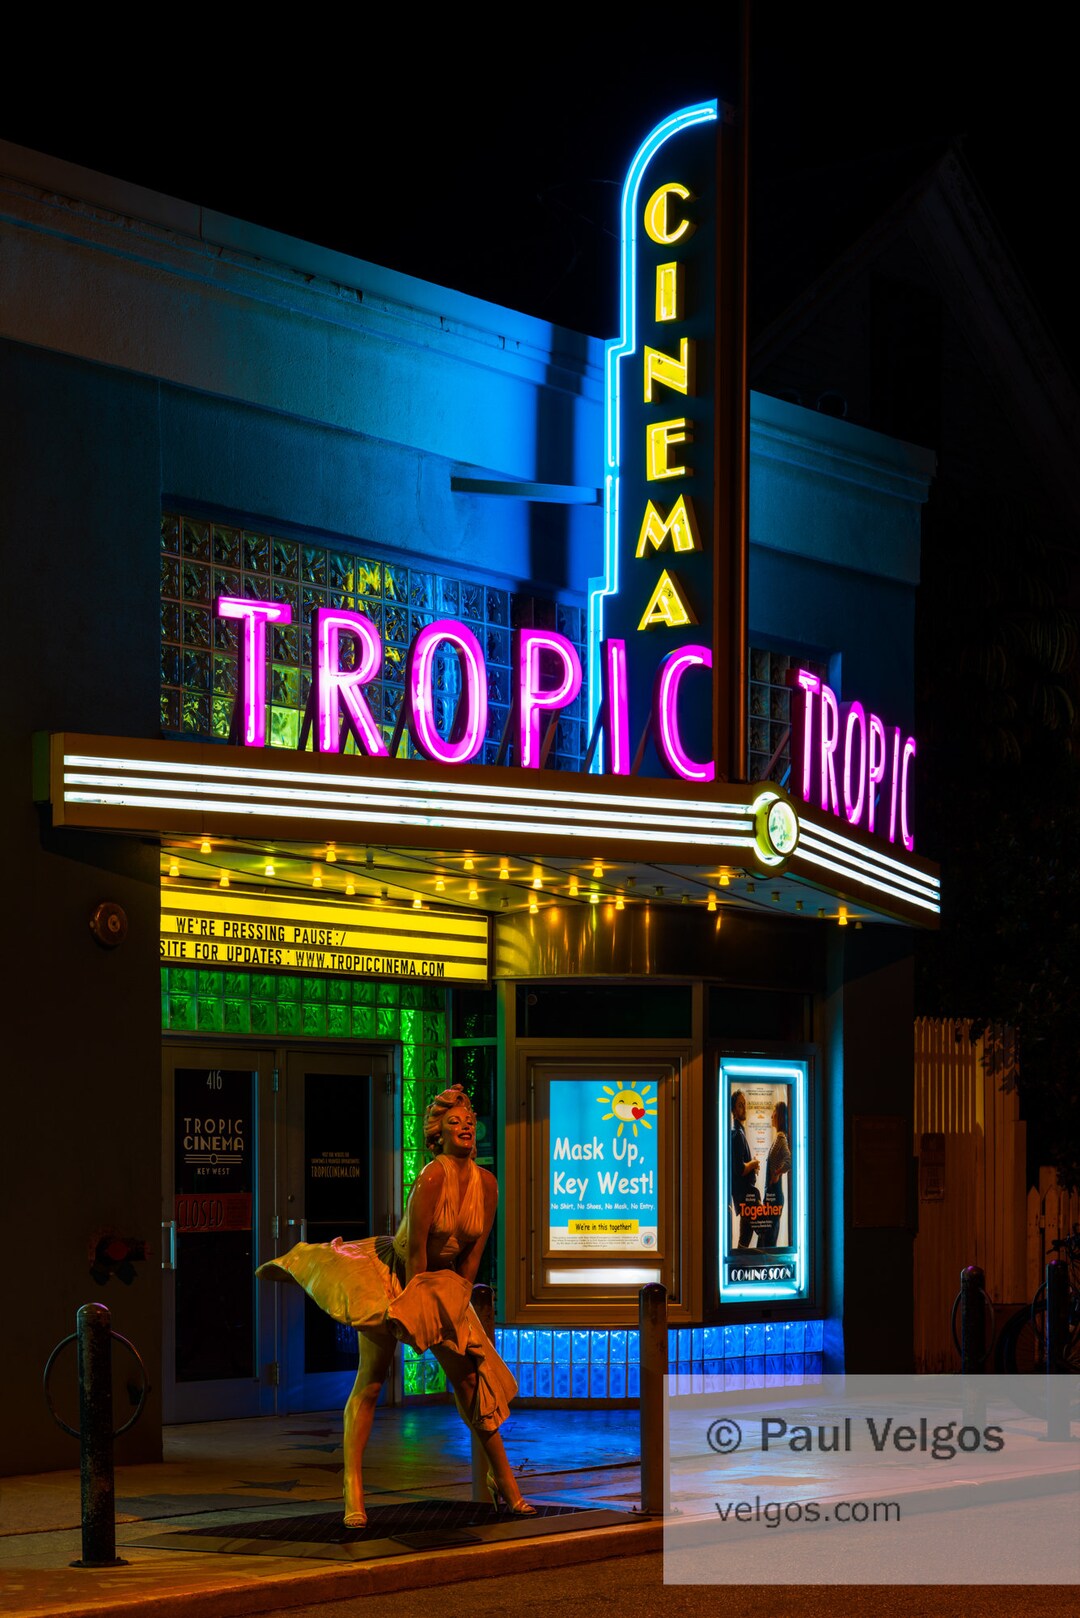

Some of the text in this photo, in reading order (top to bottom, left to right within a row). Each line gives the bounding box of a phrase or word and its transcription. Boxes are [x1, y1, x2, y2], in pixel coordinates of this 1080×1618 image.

[635, 182, 702, 631] CINEMA
[218, 596, 716, 783] TROPIC
[797, 668, 917, 852] TROPIC
[176, 917, 215, 936] WE'RE
[223, 921, 285, 942] PRESSING
[160, 940, 186, 957] SITE
[195, 943, 218, 961] FOR
[296, 950, 445, 977] WWW.TROPICCINEMA.COM
[206, 1070, 222, 1090] 416
[184, 1118, 243, 1135] TROPIC
[183, 1135, 244, 1151] CINEMA
[553, 1136, 645, 1168] Mask Up,
[197, 1167, 230, 1176] KEY WEST
[553, 1170, 653, 1201] Key West!
[177, 1199, 225, 1228] CLOSED
[560, 1203, 575, 1211] Shirt,
[586, 1203, 603, 1211] Shoes,
[614, 1203, 629, 1211] Mask,
[640, 1203, 655, 1211] Entry.
[739, 1202, 783, 1221] Together
[575, 1223, 632, 1232] We're in this together!
[731, 1267, 791, 1281] COMING SOON
